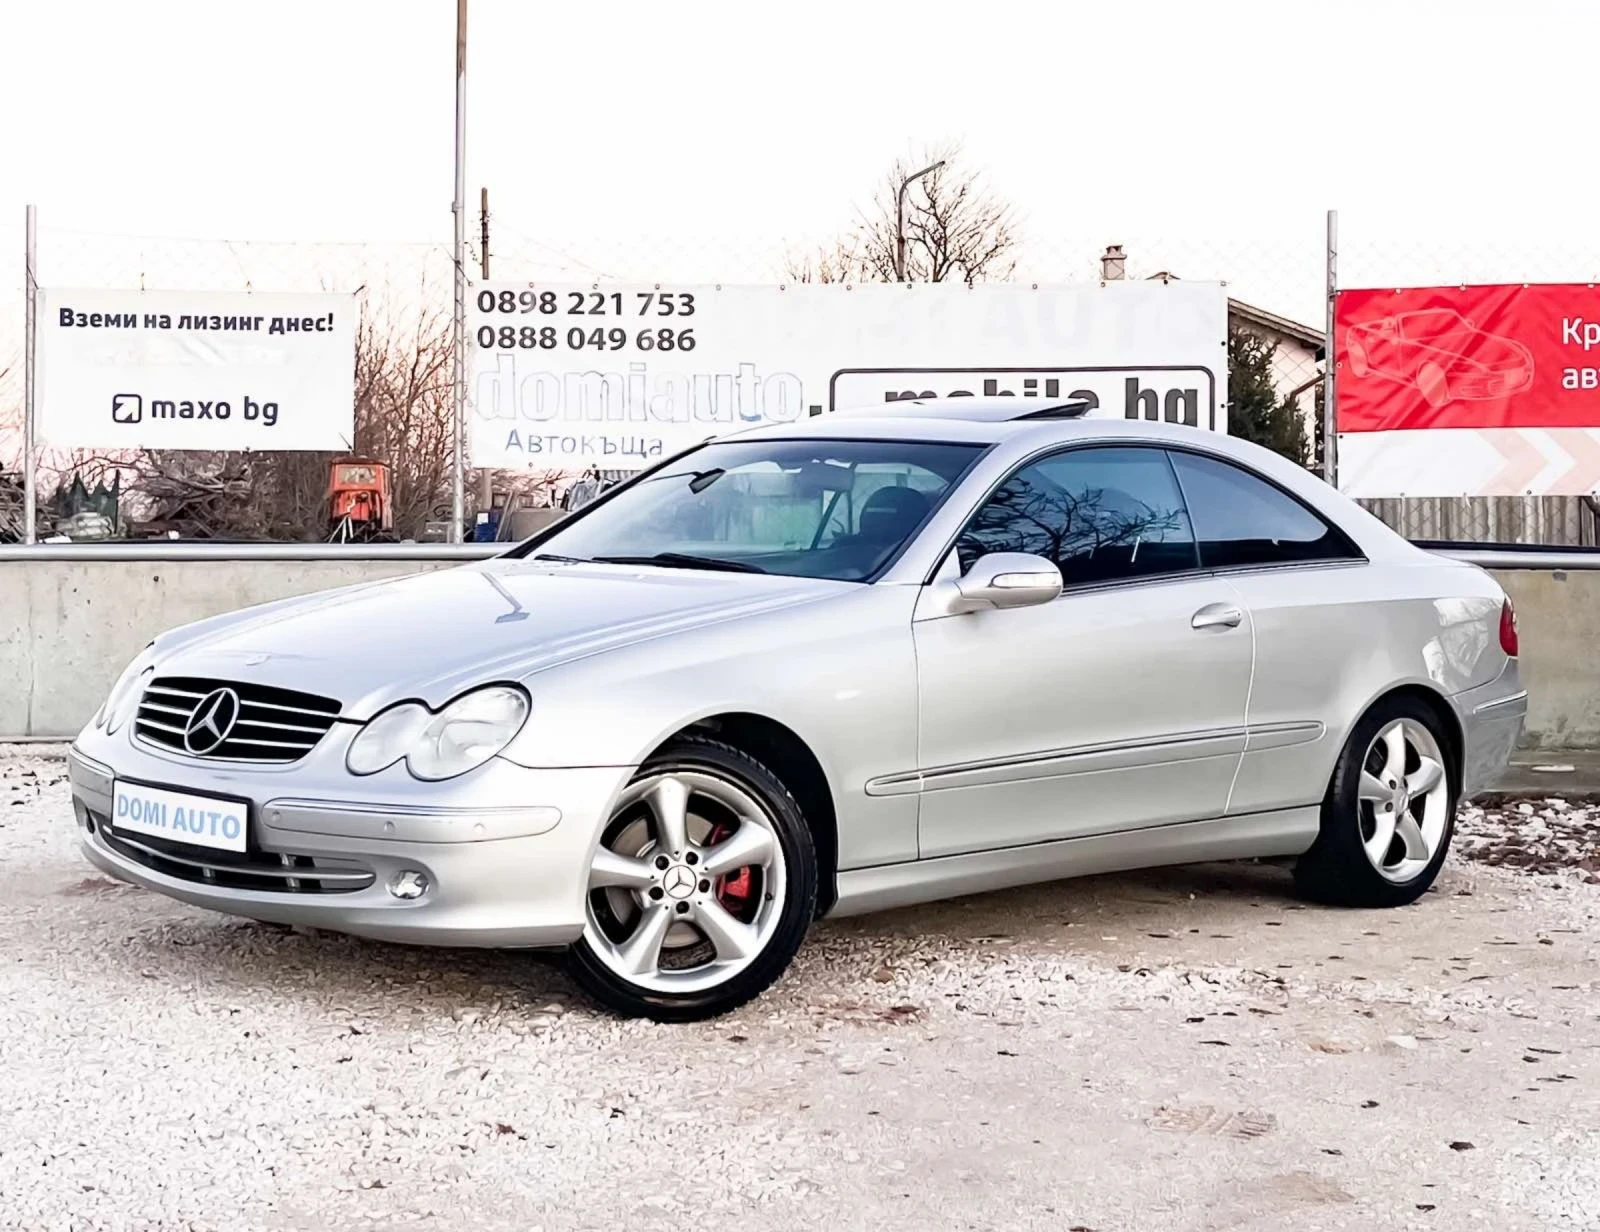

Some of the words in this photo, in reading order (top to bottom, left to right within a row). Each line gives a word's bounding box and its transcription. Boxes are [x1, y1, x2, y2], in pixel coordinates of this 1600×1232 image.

[476, 289, 558, 315] 0898
[566, 291, 623, 316] 221
[636, 292, 697, 317] 753
[58, 307, 137, 330] Вземи
[143, 313, 172, 331] на
[177, 314, 265, 332] лизинг
[268, 312, 334, 335] днес!
[476, 325, 558, 350] 0888
[566, 326, 627, 352] 049
[635, 327, 697, 352] 686
[150, 399, 231, 420] maxo
[243, 395, 279, 426] bg
[505, 429, 663, 458] Автокъща
[117, 794, 167, 827] DOMI
[173, 806, 240, 839] AUTO
